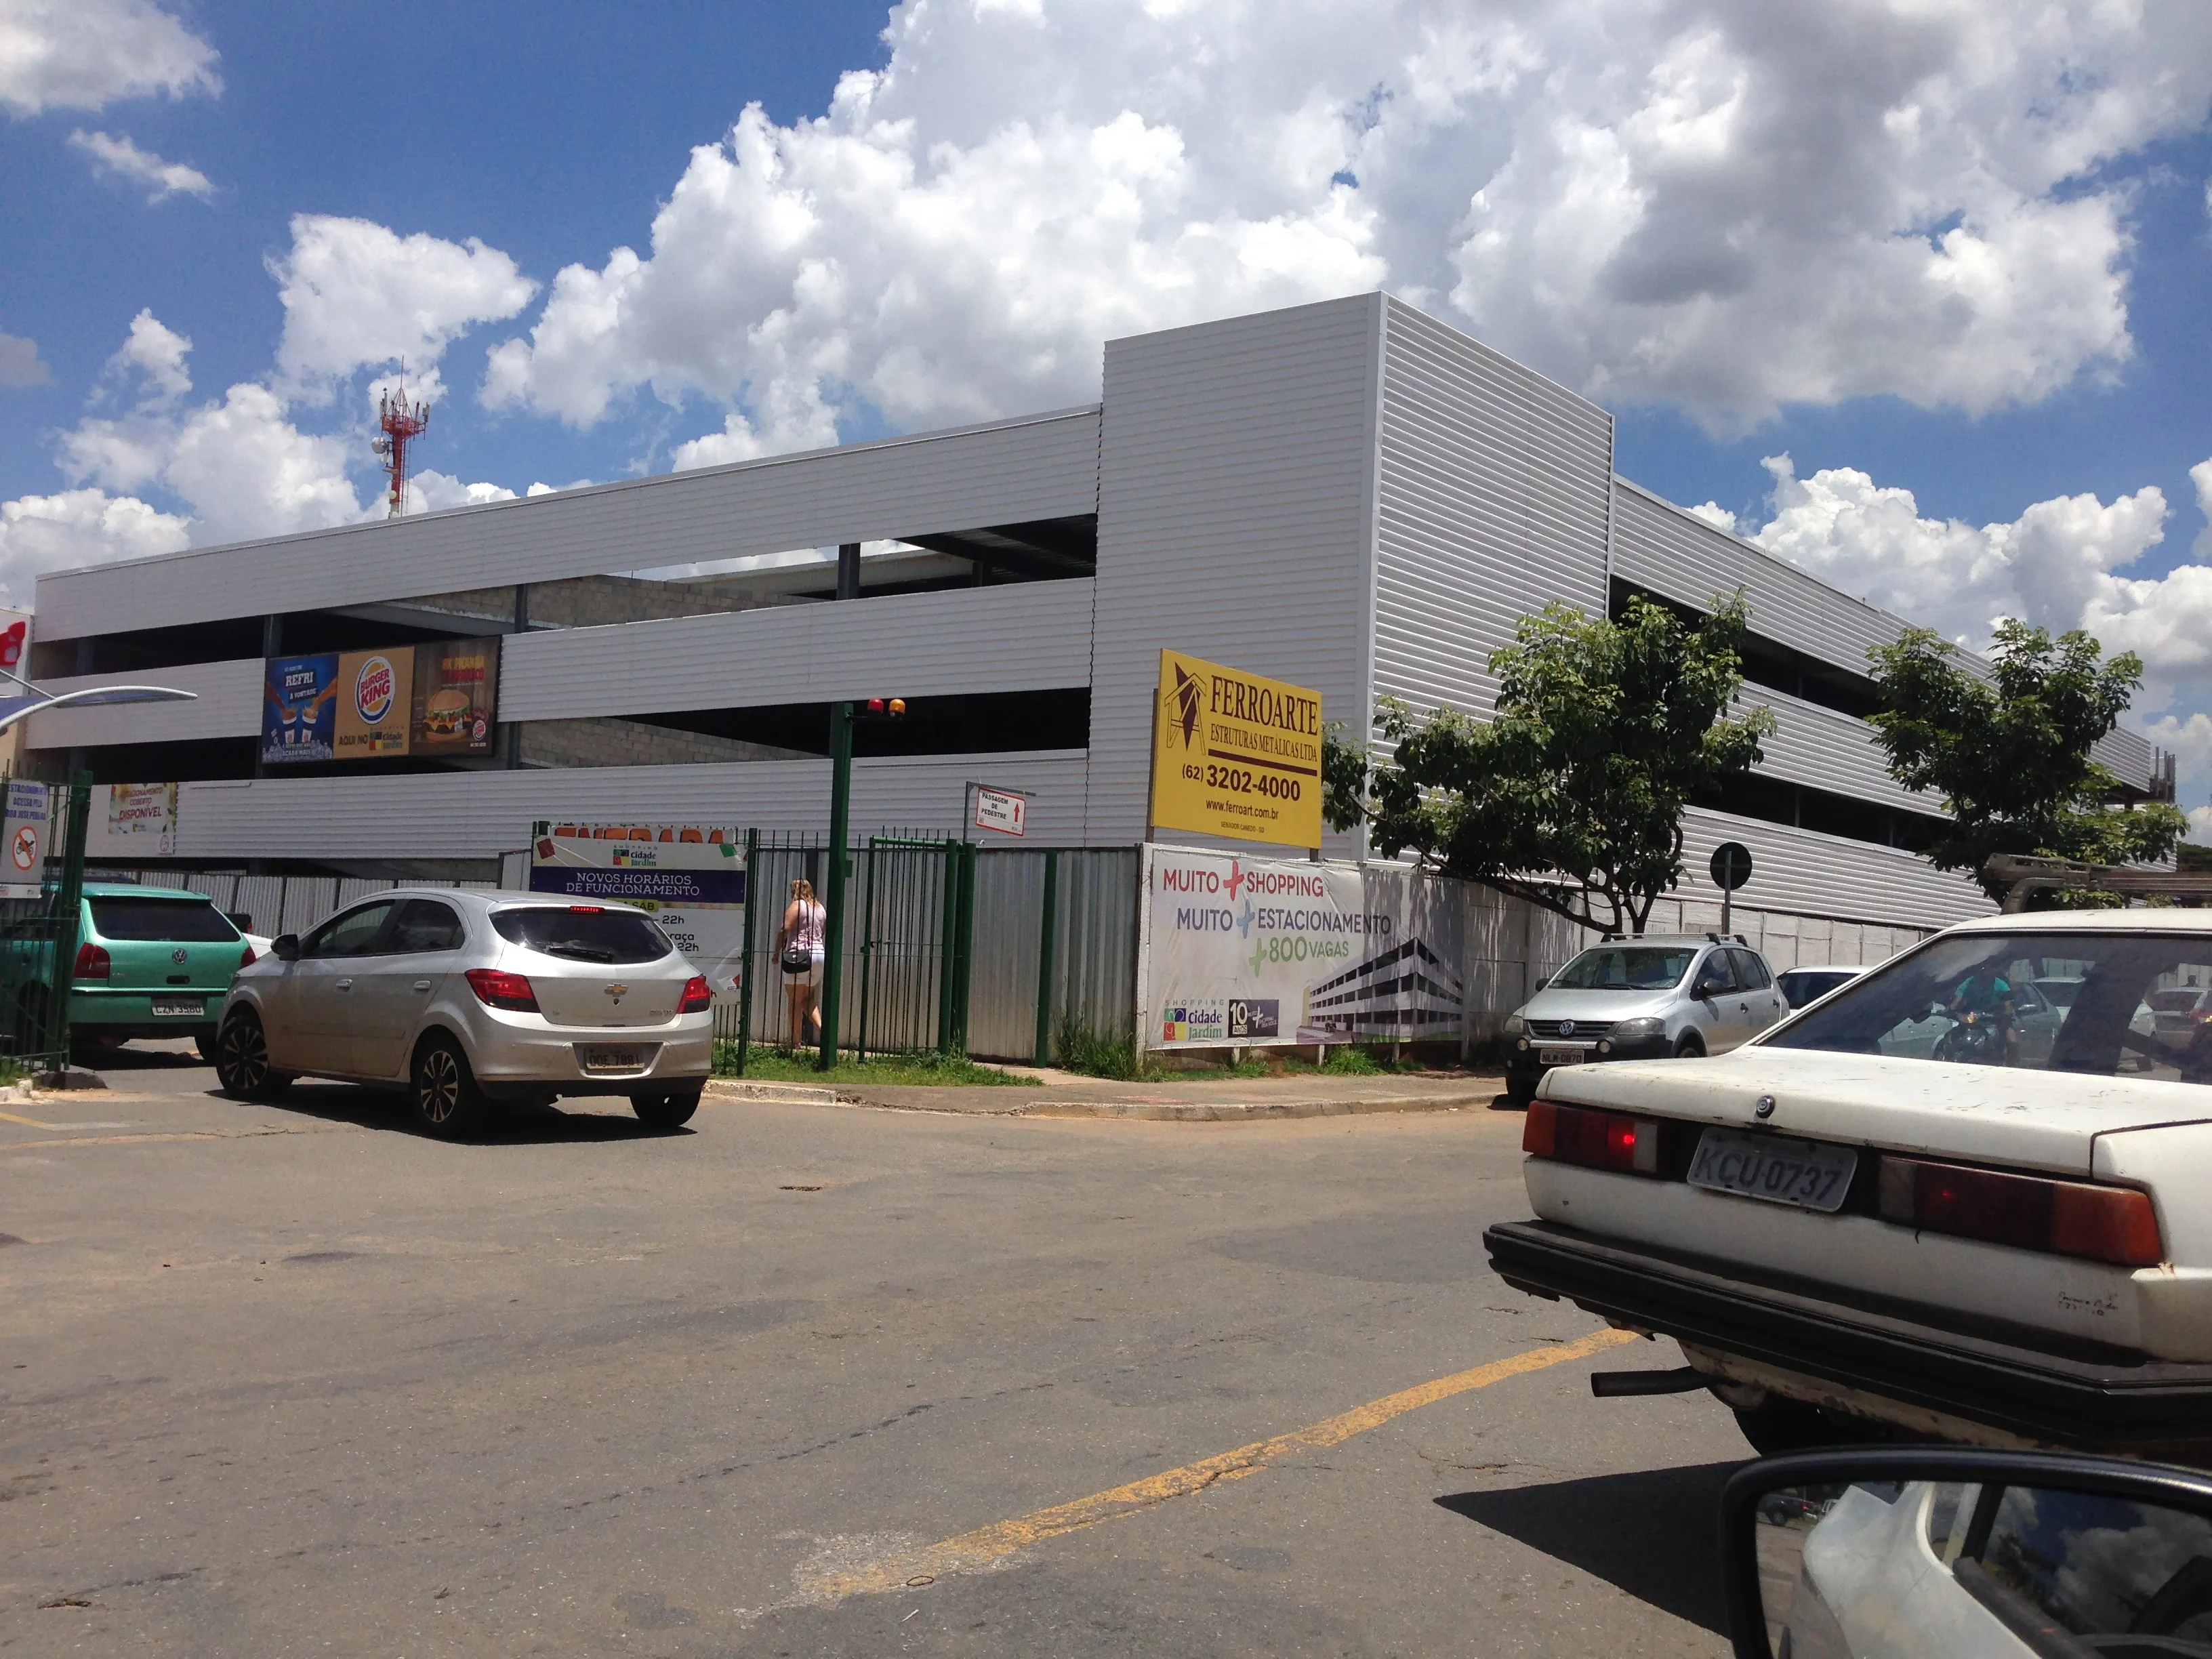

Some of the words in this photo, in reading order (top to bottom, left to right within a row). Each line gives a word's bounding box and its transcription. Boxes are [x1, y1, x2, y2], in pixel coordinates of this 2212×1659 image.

[285, 672, 314, 687] REFRI
[361, 668, 390, 694] BURGER
[361, 679, 390, 709] KING
[1210, 674, 1318, 737] FERROARTE
[339, 735, 356, 745] AQUI
[358, 735, 368, 744] NO
[1210, 723, 1258, 750] ESTRUTURAS
[1258, 733, 1299, 759] METÁLICAS
[1300, 745, 1318, 762] LTDA
[1182, 764, 1204, 783] (62)
[1206, 764, 1300, 802] 3202-4000
[982, 792, 1008, 804] PASSAGEM
[981, 808, 1006, 819] PEDESTRE
[1206, 799, 1279, 820] www.ferroart.com.br
[630, 851, 656, 859] cidade
[577, 872, 620, 883] NOVOS
[623, 873, 691, 885] HORÁRIOS
[1163, 868, 1219, 894] MUITO
[1247, 872, 1324, 897] SHOPPING
[566, 883, 582, 892] DE
[586, 884, 700, 896] FUNCIONAMENTO
[662, 915, 684, 924] 22h
[1177, 907, 1233, 931] MUITO
[1258, 907, 1391, 935] ESTACIONAMENTO
[668, 933, 695, 943] raça
[1309, 941, 1349, 958] VAGAS
[1165, 999, 1225, 1007] SHOPPING
[1189, 1008, 1223, 1024] cidade
[1230, 1002, 1248, 1025] 10
[1233, 1025, 1247, 1033] ANOS
